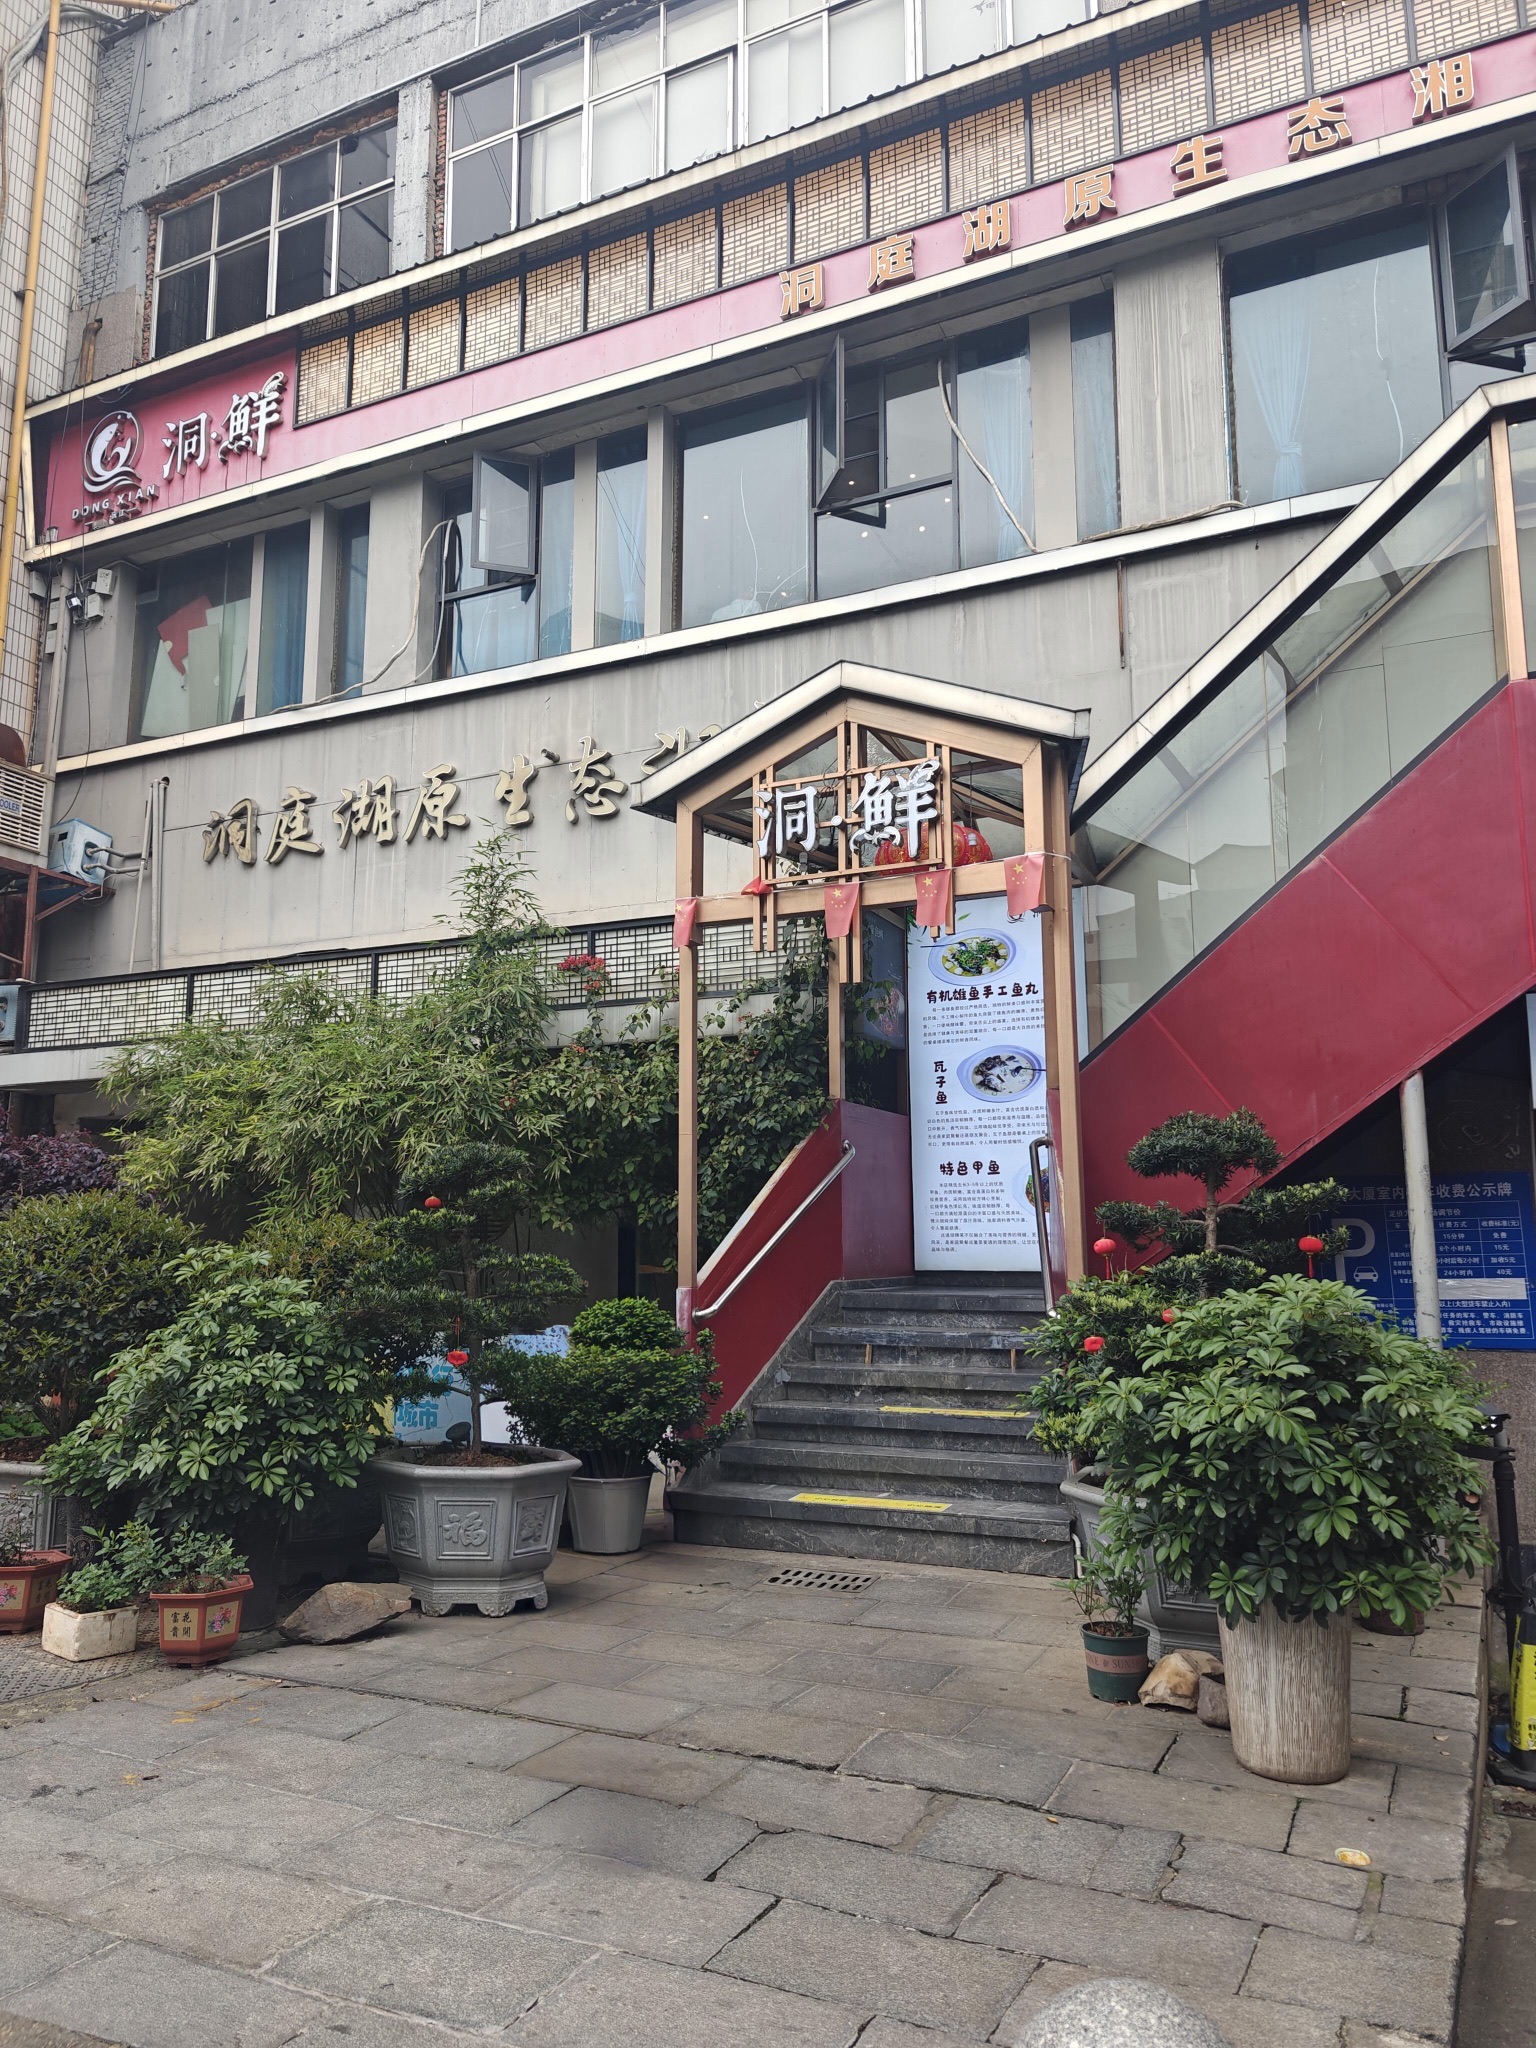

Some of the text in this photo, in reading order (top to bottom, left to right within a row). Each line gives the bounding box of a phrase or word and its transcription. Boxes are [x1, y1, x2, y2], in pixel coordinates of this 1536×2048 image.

[779, 53, 1476, 319] 洞庭湖原生态湘
[72, 484, 156, 520] DONG XIAN
[926, 982, 1039, 1004] 有机雄鱼手工鱼丸
[933, 1060, 948, 1104] 瓦子鱼
[939, 1160, 1001, 1176] 特色甲鱼
[1348, 1181, 1513, 1201] 大厦室内收费公示牌
[1438, 1219, 1467, 1228] 计费方式
[1490, 1256, 1516, 1264] 加收5元
[443, 1511, 488, 1547] 福
